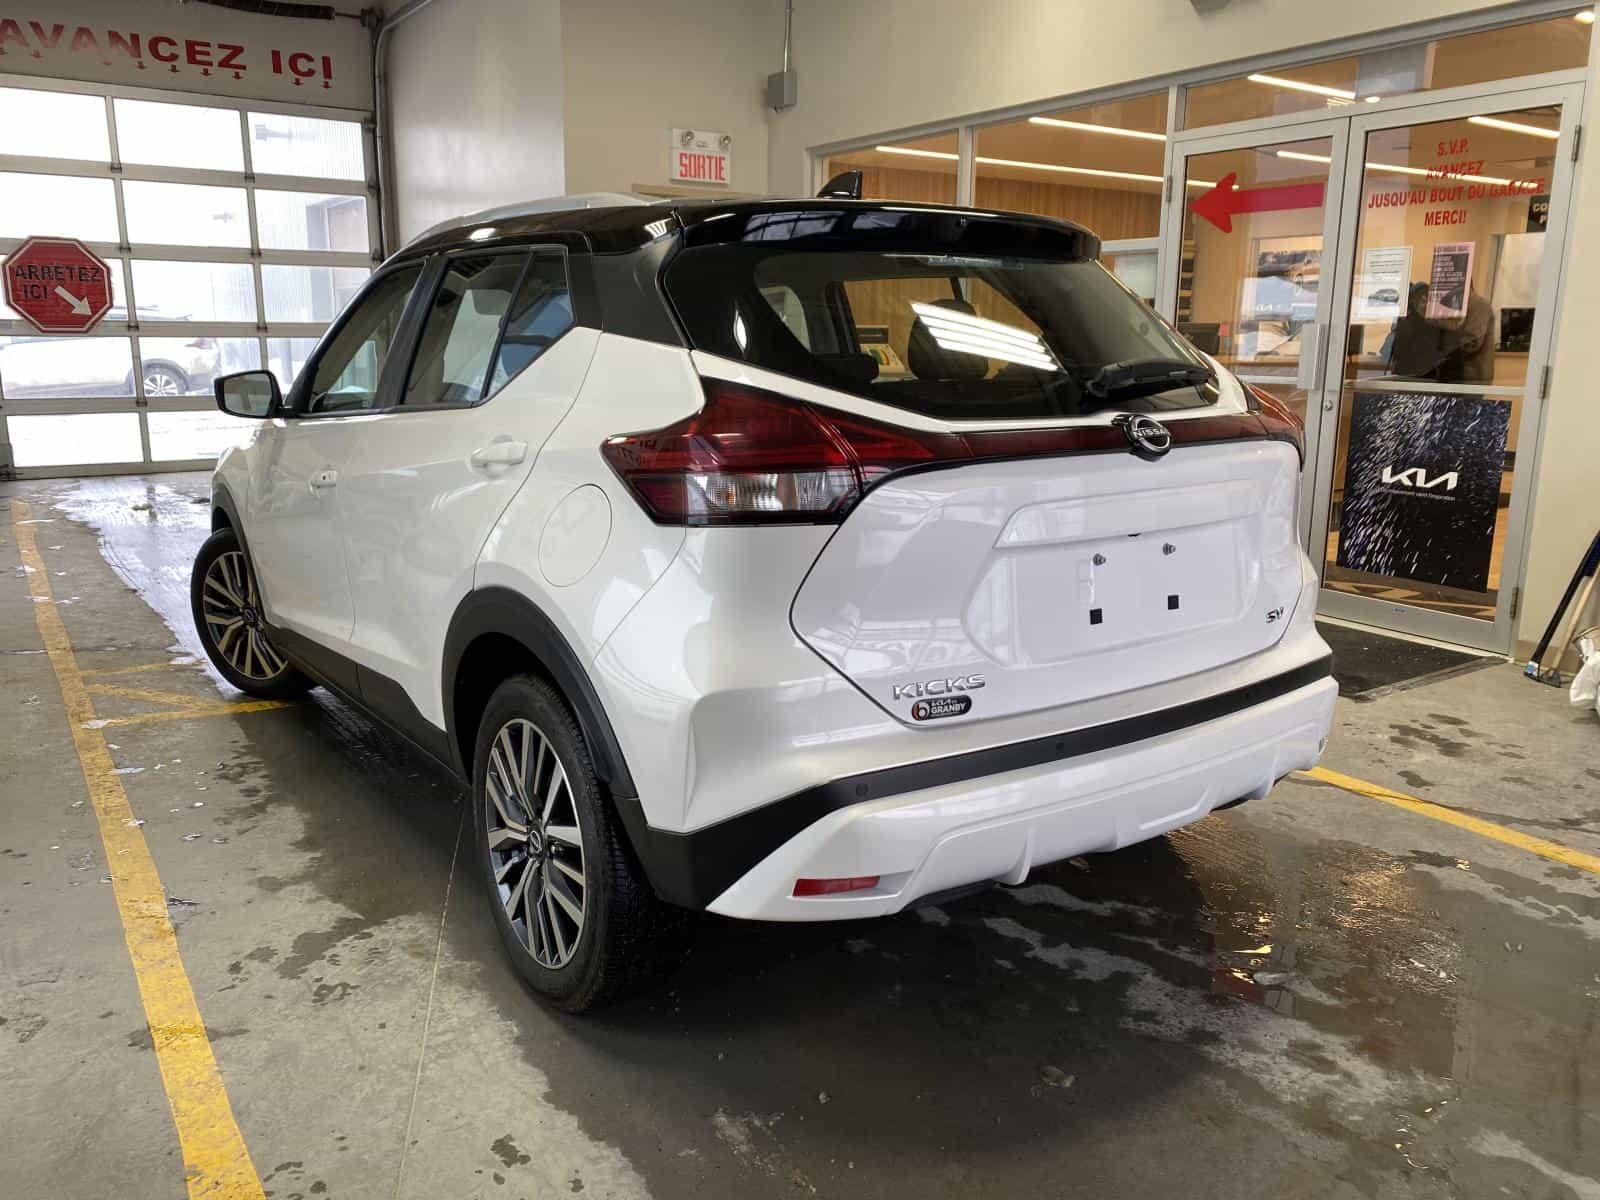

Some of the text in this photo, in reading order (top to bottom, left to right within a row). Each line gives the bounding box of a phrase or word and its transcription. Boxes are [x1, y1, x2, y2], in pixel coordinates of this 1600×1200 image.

[679, 152, 726, 181] SORTIE
[1426, 160, 1484, 180] AVANCEZ
[1368, 177, 1547, 209] JUSQU'AU BOUT DU GARAGE
[23, 284, 49, 300] ICI
[1382, 465, 1458, 491] KIA
[1266, 606, 1284, 624] SV
[893, 673, 985, 700] KICKS
[931, 703, 966, 714] GRANBY
